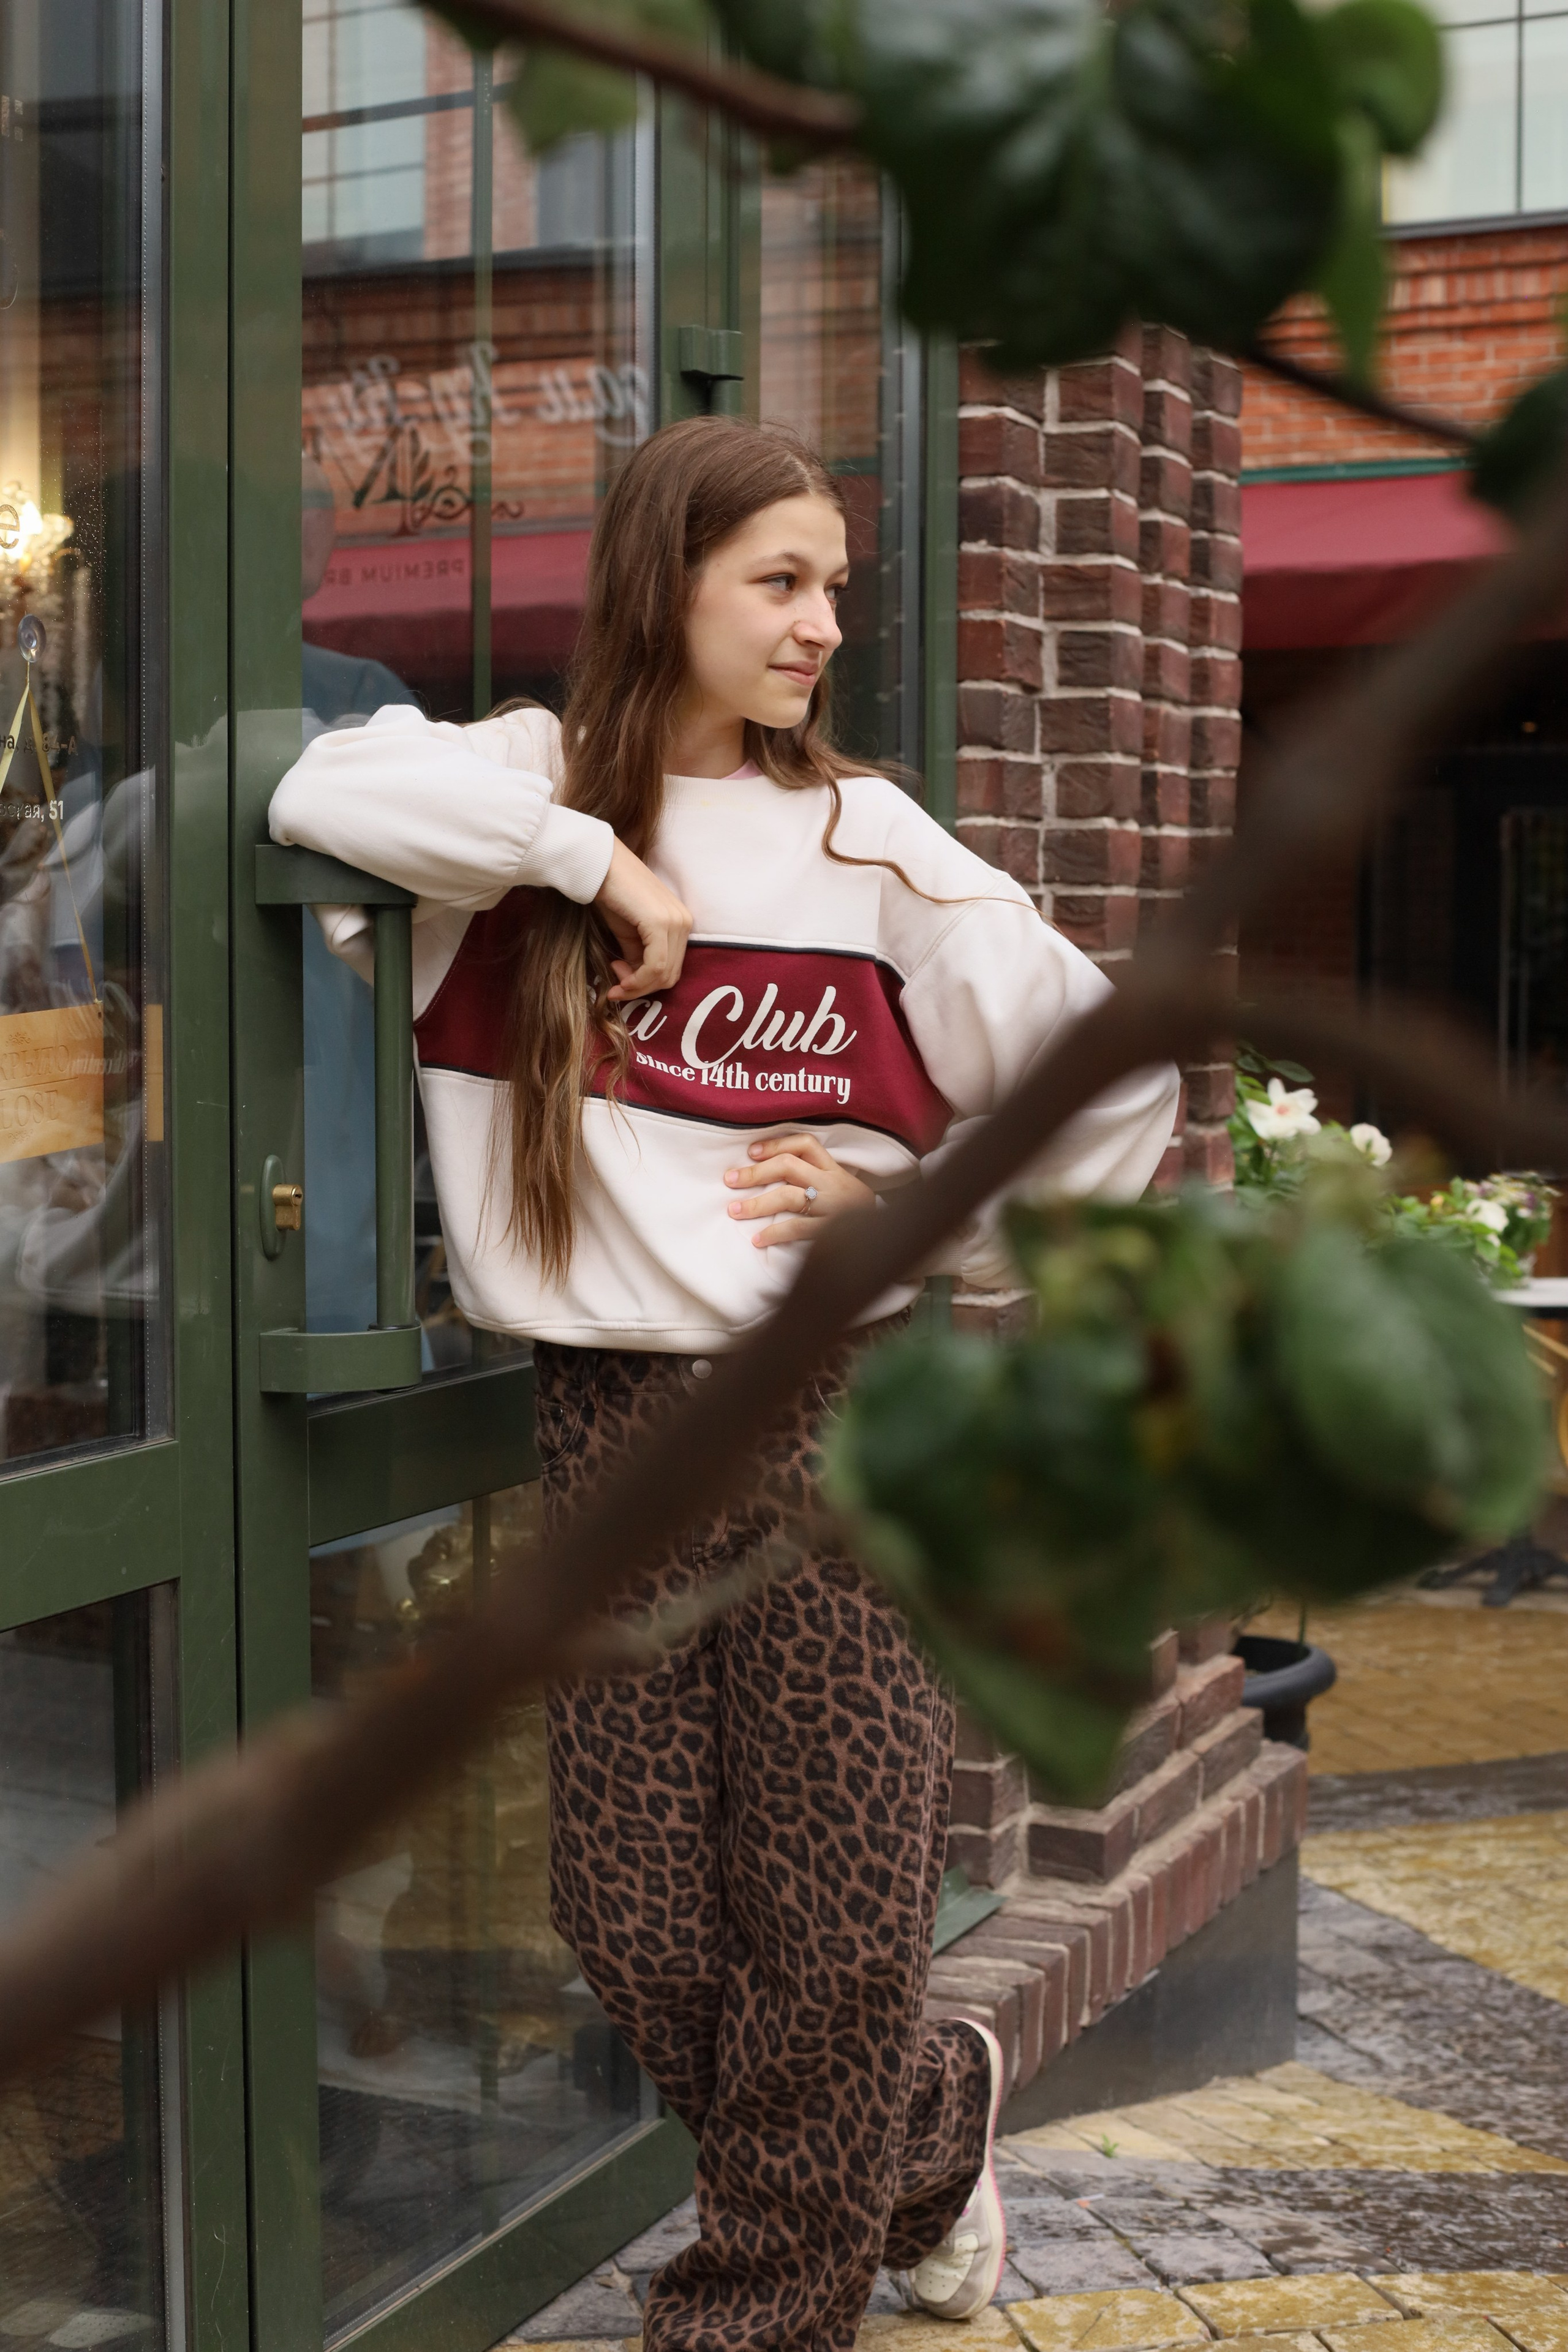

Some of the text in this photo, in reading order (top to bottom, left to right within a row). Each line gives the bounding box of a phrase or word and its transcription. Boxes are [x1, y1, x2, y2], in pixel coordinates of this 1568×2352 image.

[49, 800, 64, 820] 51
[681, 983, 857, 1069] Club
[636, 1051, 851, 1104] since 14th century
